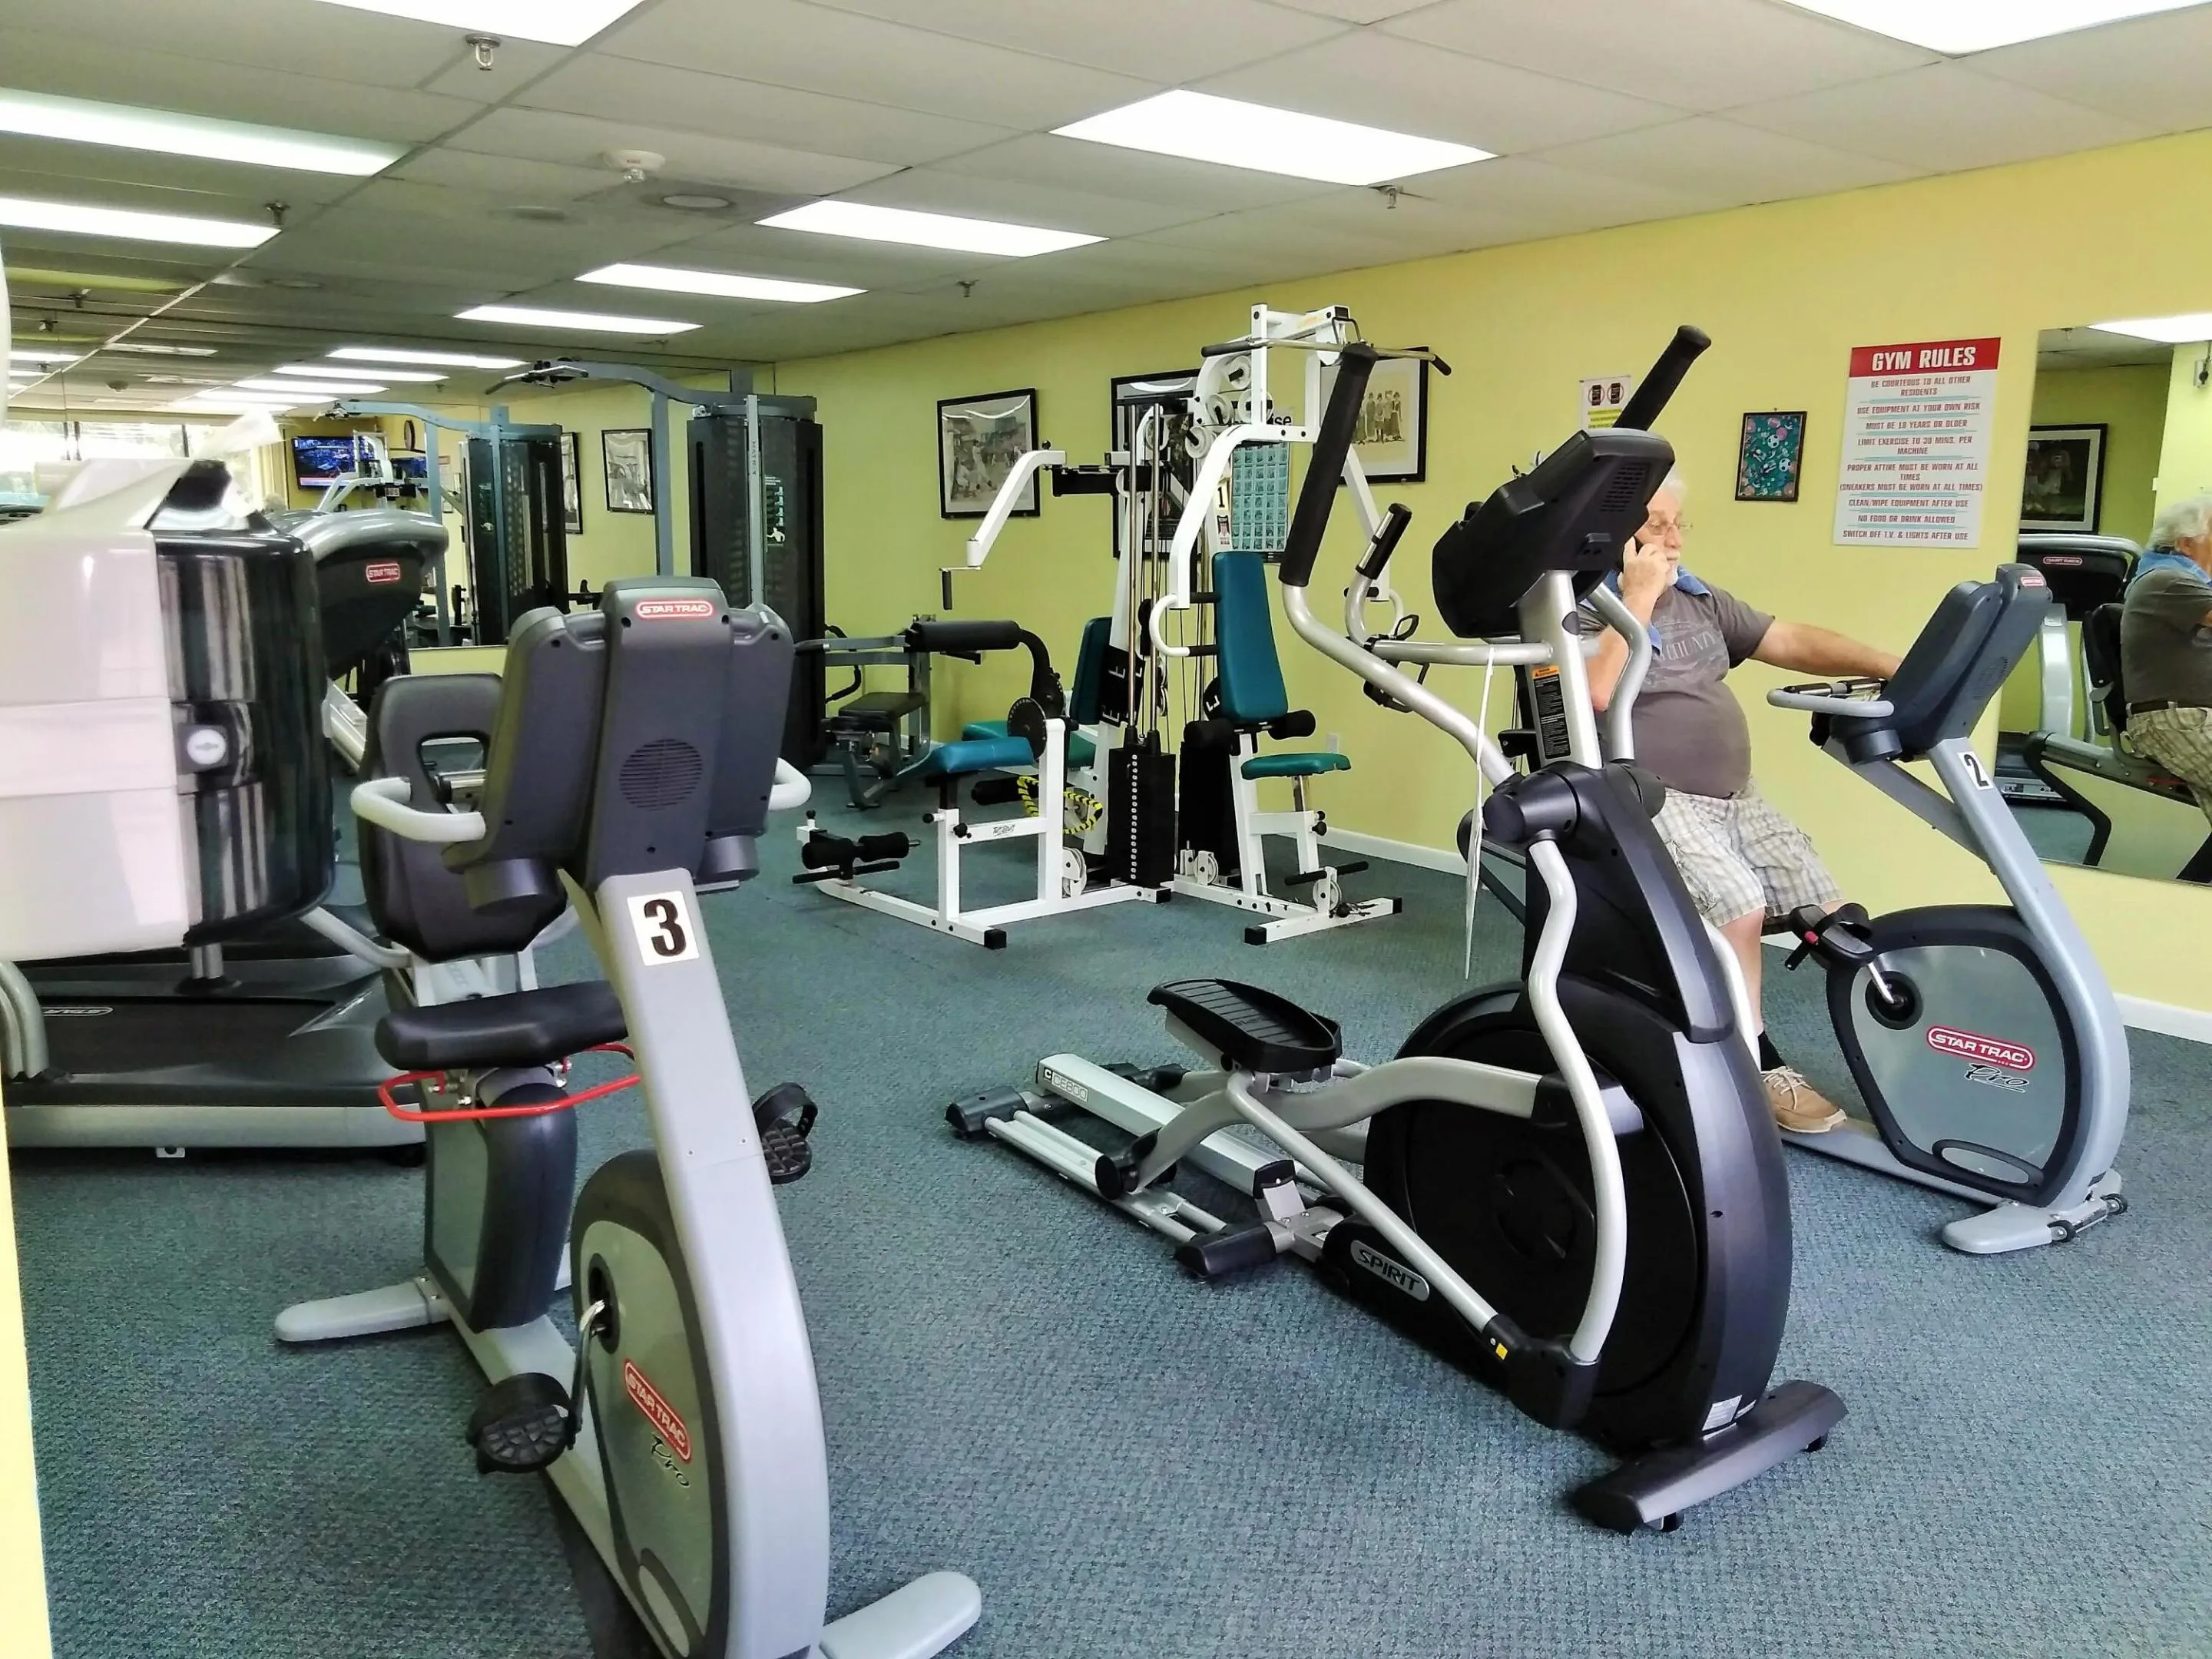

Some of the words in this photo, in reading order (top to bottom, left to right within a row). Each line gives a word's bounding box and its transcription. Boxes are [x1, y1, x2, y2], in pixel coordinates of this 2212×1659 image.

[1872, 351, 1912, 371] GYM
[1919, 346, 1976, 369] RULES
[1882, 379, 1920, 388] COURTEOUS
[1933, 376, 1945, 385] ALL
[1948, 376, 1971, 384] OTHER
[1900, 388, 1938, 396] RESIDENTS
[1856, 406, 1869, 415] USE
[1872, 405, 1909, 414] EQUIPMENT
[1878, 437, 1909, 445] EXERCISE
[1959, 435, 1972, 444] PER
[1932, 462, 1953, 471] WORN
[1959, 483, 1983, 492] TIMES)
[1924, 515, 1955, 524] ALLOWED
[642, 605, 674, 614] STAR
[674, 604, 706, 613] TRAC
[1964, 754, 1989, 786] 2
[644, 899, 687, 957] 3
[1933, 1034, 1976, 1051] STAR
[1979, 1044, 2025, 1063] TRAC
[1964, 1063, 2029, 1087] Pro
[1358, 1249, 1420, 1290] SPIRIT
[627, 1373, 655, 1412] STAR
[656, 1405, 686, 1448] TRAC
